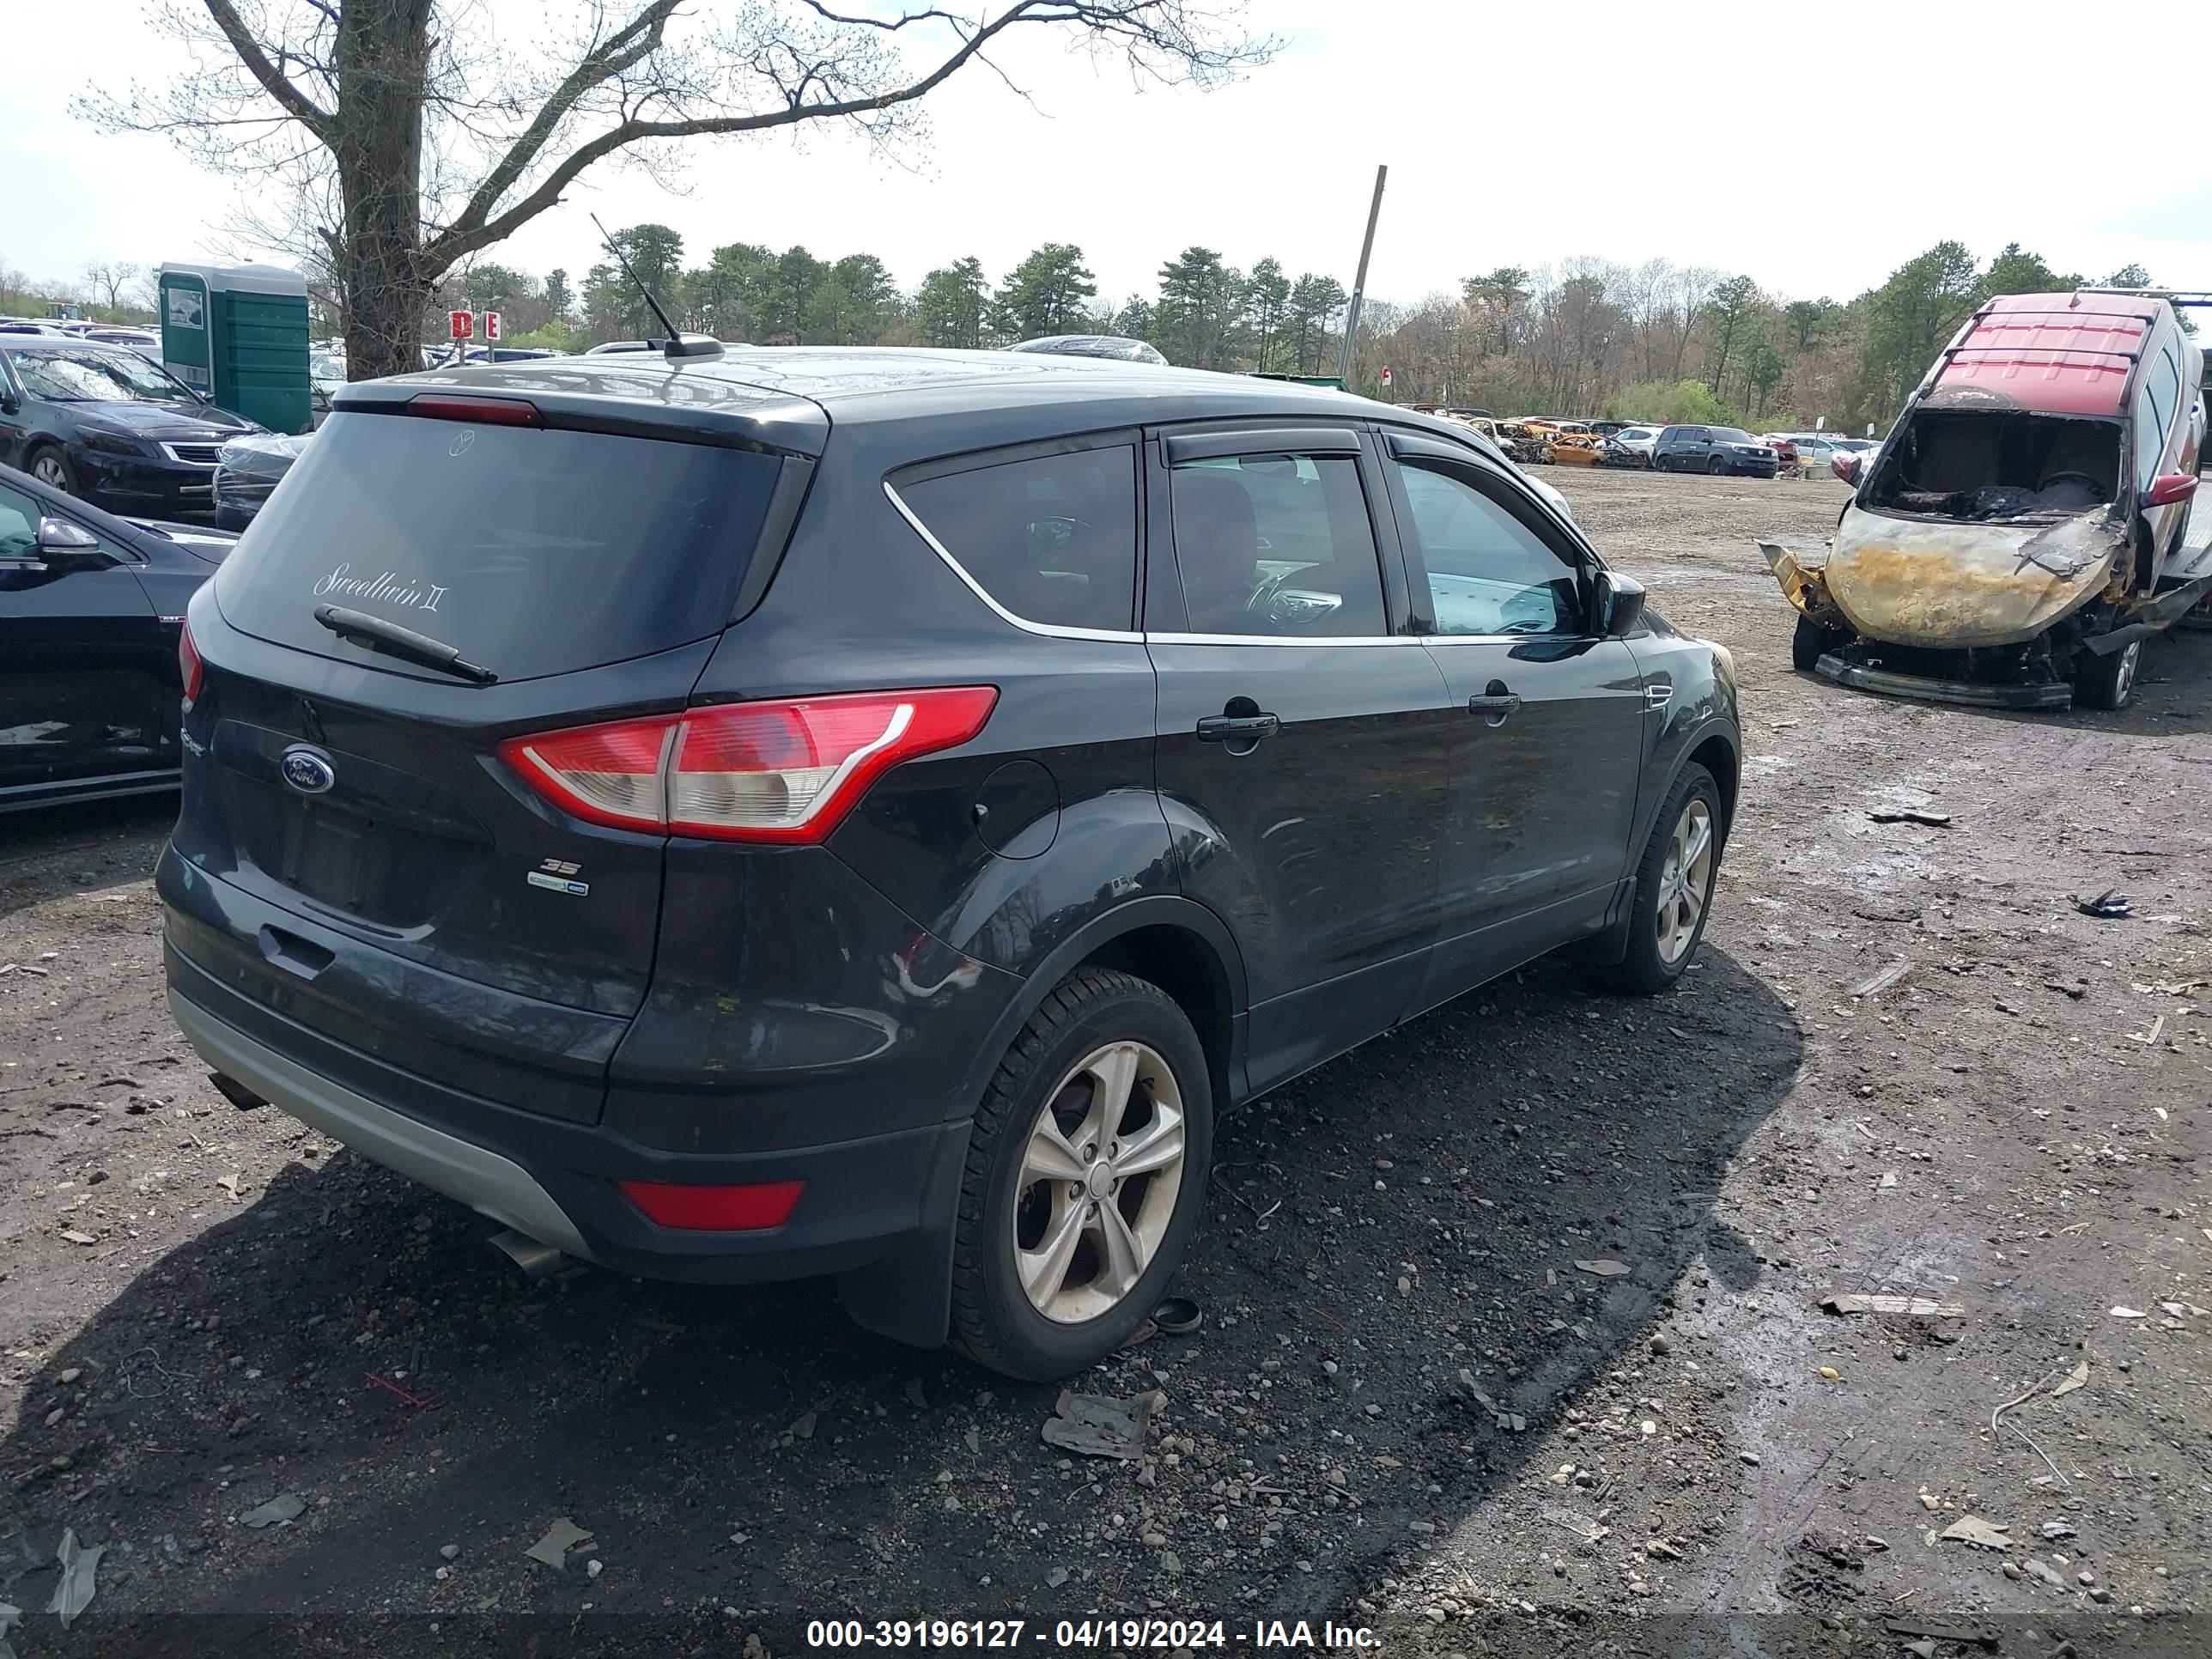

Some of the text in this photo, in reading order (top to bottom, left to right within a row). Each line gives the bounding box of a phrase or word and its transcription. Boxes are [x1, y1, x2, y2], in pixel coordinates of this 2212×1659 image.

[453, 313, 472, 337] D
[488, 313, 497, 337] E
[289, 758, 318, 785] Ford
